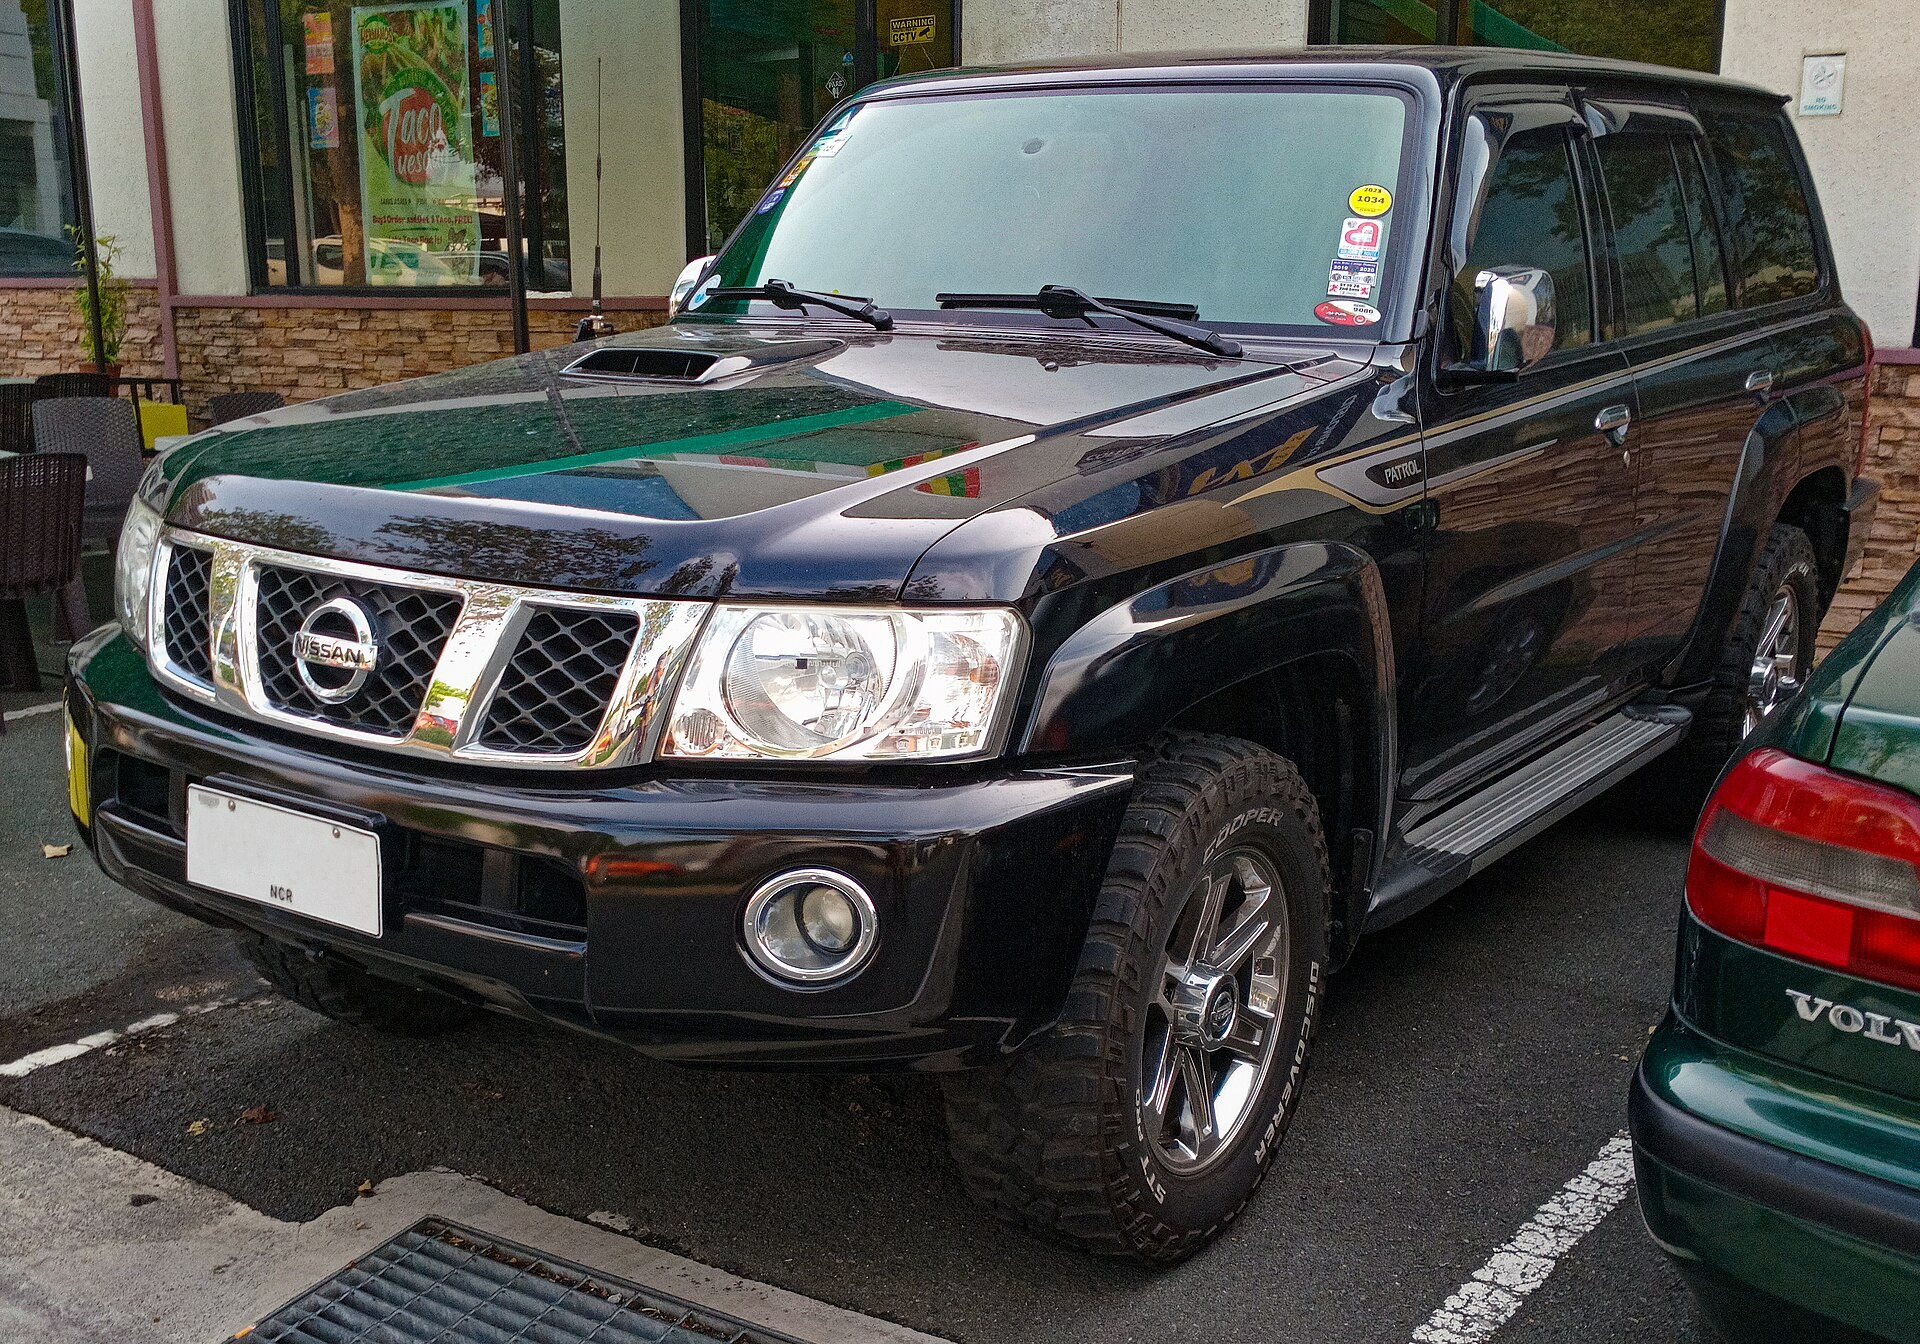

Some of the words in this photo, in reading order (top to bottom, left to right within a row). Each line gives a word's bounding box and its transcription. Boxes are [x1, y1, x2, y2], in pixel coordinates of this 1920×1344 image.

[892, 18, 934, 29] WARNING
[892, 32, 917, 42] CCTV
[1357, 195, 1385, 204] 1034
[1384, 459, 1422, 484] PATROL
[296, 635, 362, 664] NISSAN
[1203, 807, 1285, 865] COOPER
[270, 884, 293, 903] NCR
[1254, 960, 1320, 1166] DISCOVERER
[1135, 1088, 1144, 1142] PRO
